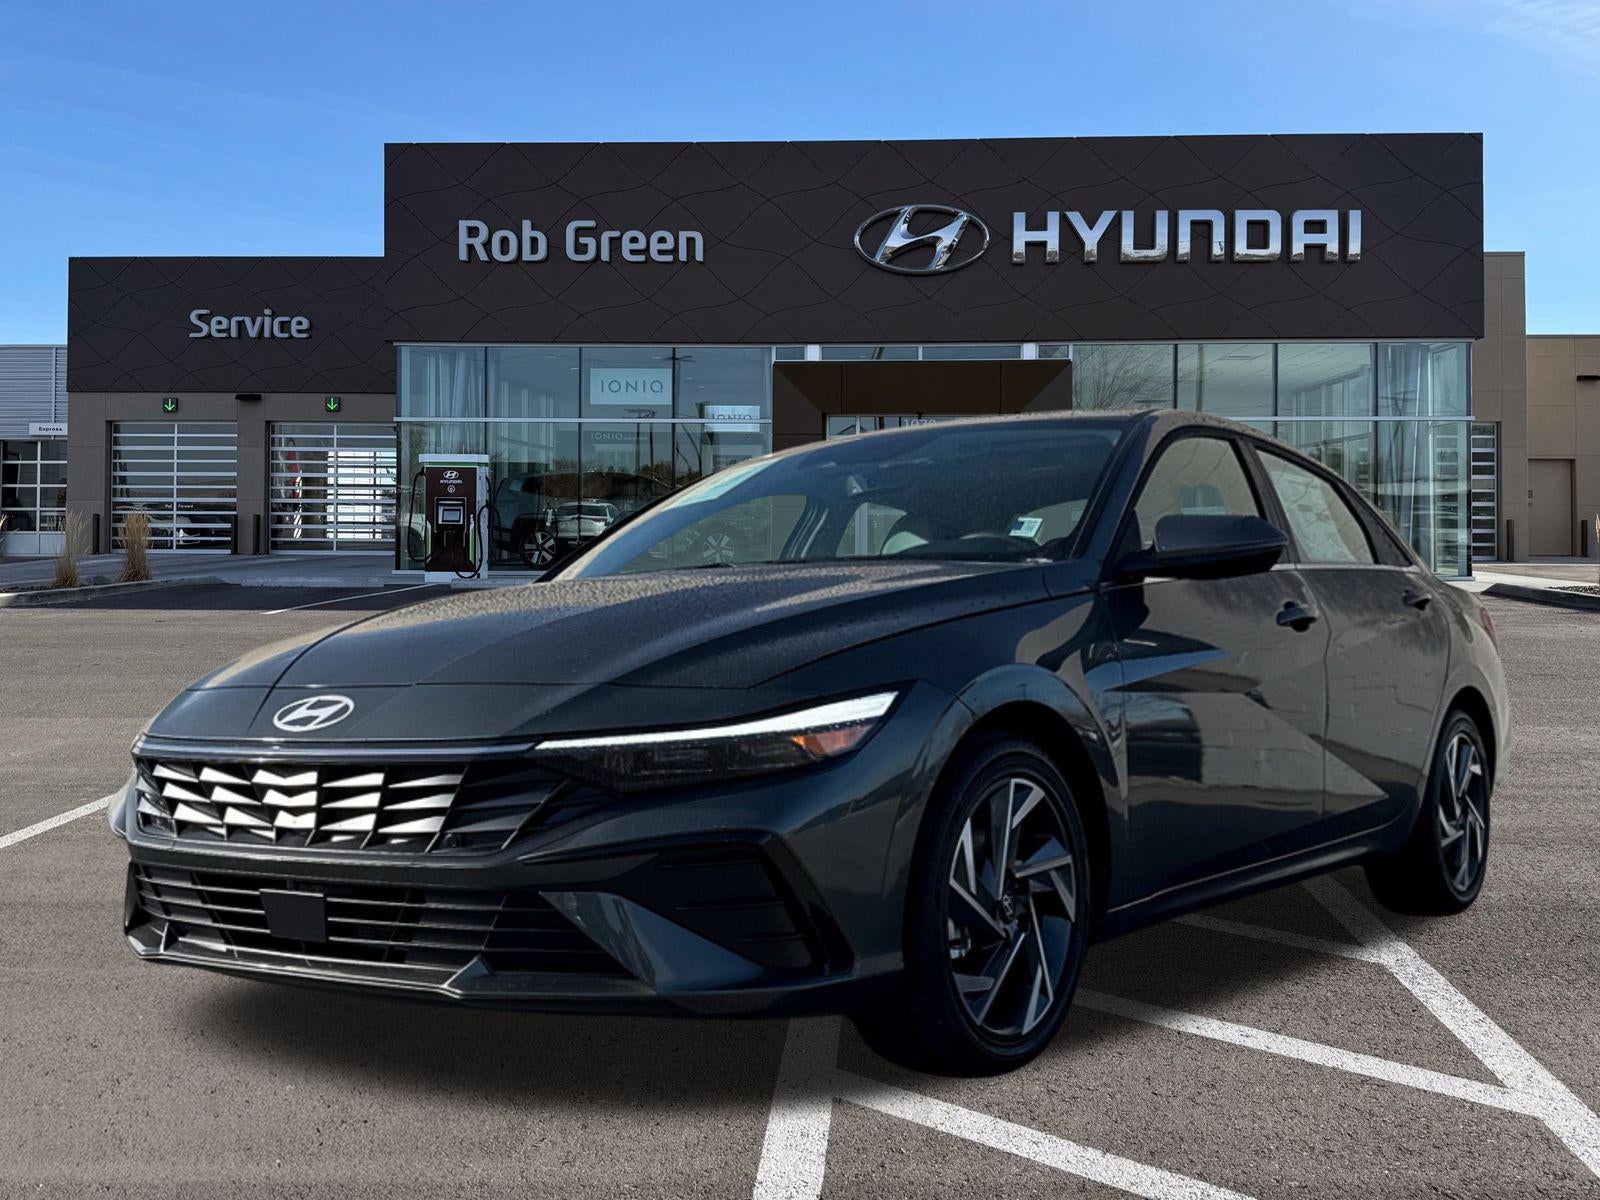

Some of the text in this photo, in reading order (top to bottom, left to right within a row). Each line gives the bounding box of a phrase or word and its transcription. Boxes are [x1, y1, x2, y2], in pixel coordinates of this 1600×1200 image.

[458, 219, 705, 262] Rob Green
[1011, 208, 1363, 264] HYUNDAI
[188, 308, 311, 339] Service
[600, 379, 664, 394] IONIQ
[591, 432, 624, 440] IONIQ
